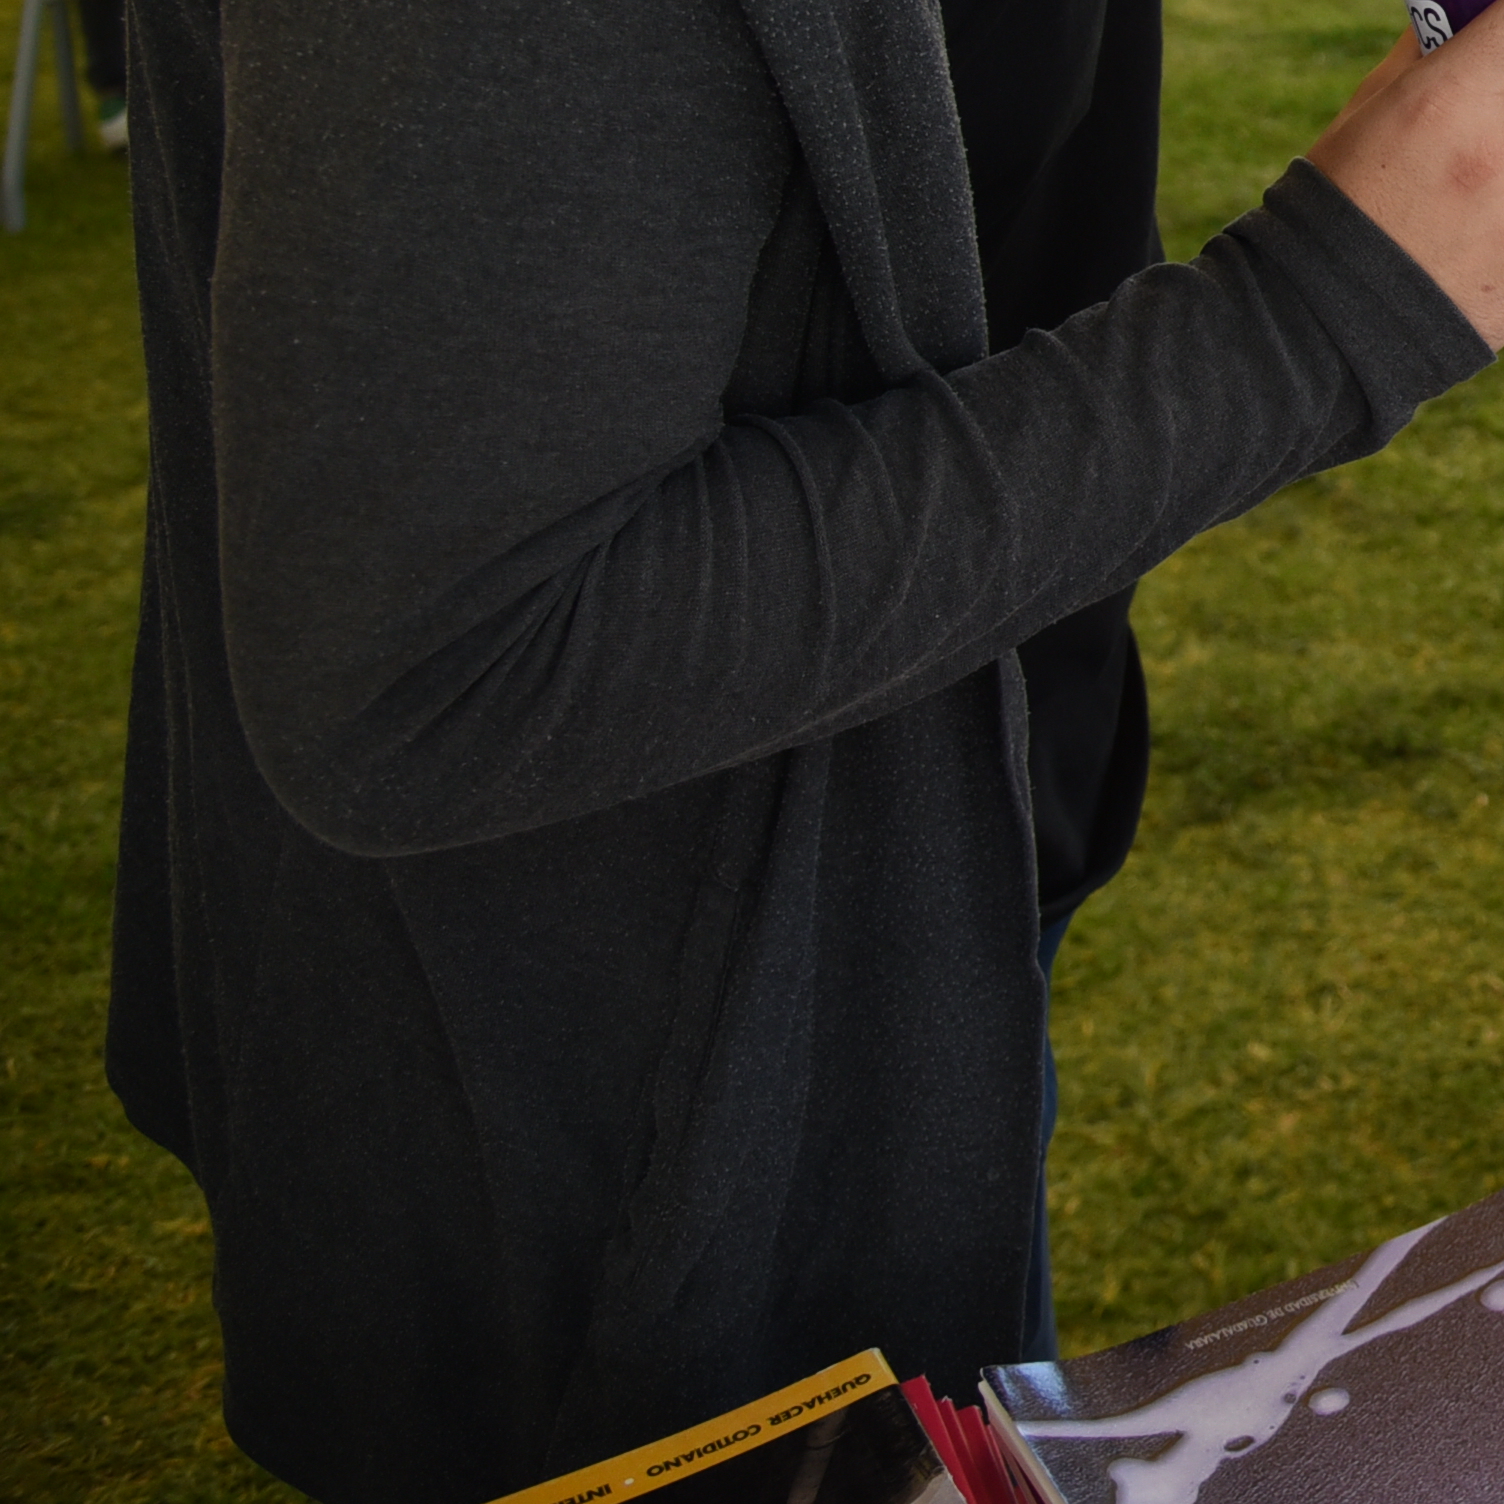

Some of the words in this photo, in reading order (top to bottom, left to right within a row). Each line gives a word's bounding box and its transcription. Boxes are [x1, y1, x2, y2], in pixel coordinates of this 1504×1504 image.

[1285, 1279, 1360, 1313] UNIVERSIDAD
[1184, 1313, 1268, 1351] GUADALAJARA
[766, 1373, 873, 1428] QUEHACER
[645, 1423, 763, 1479] COTIDIANO
